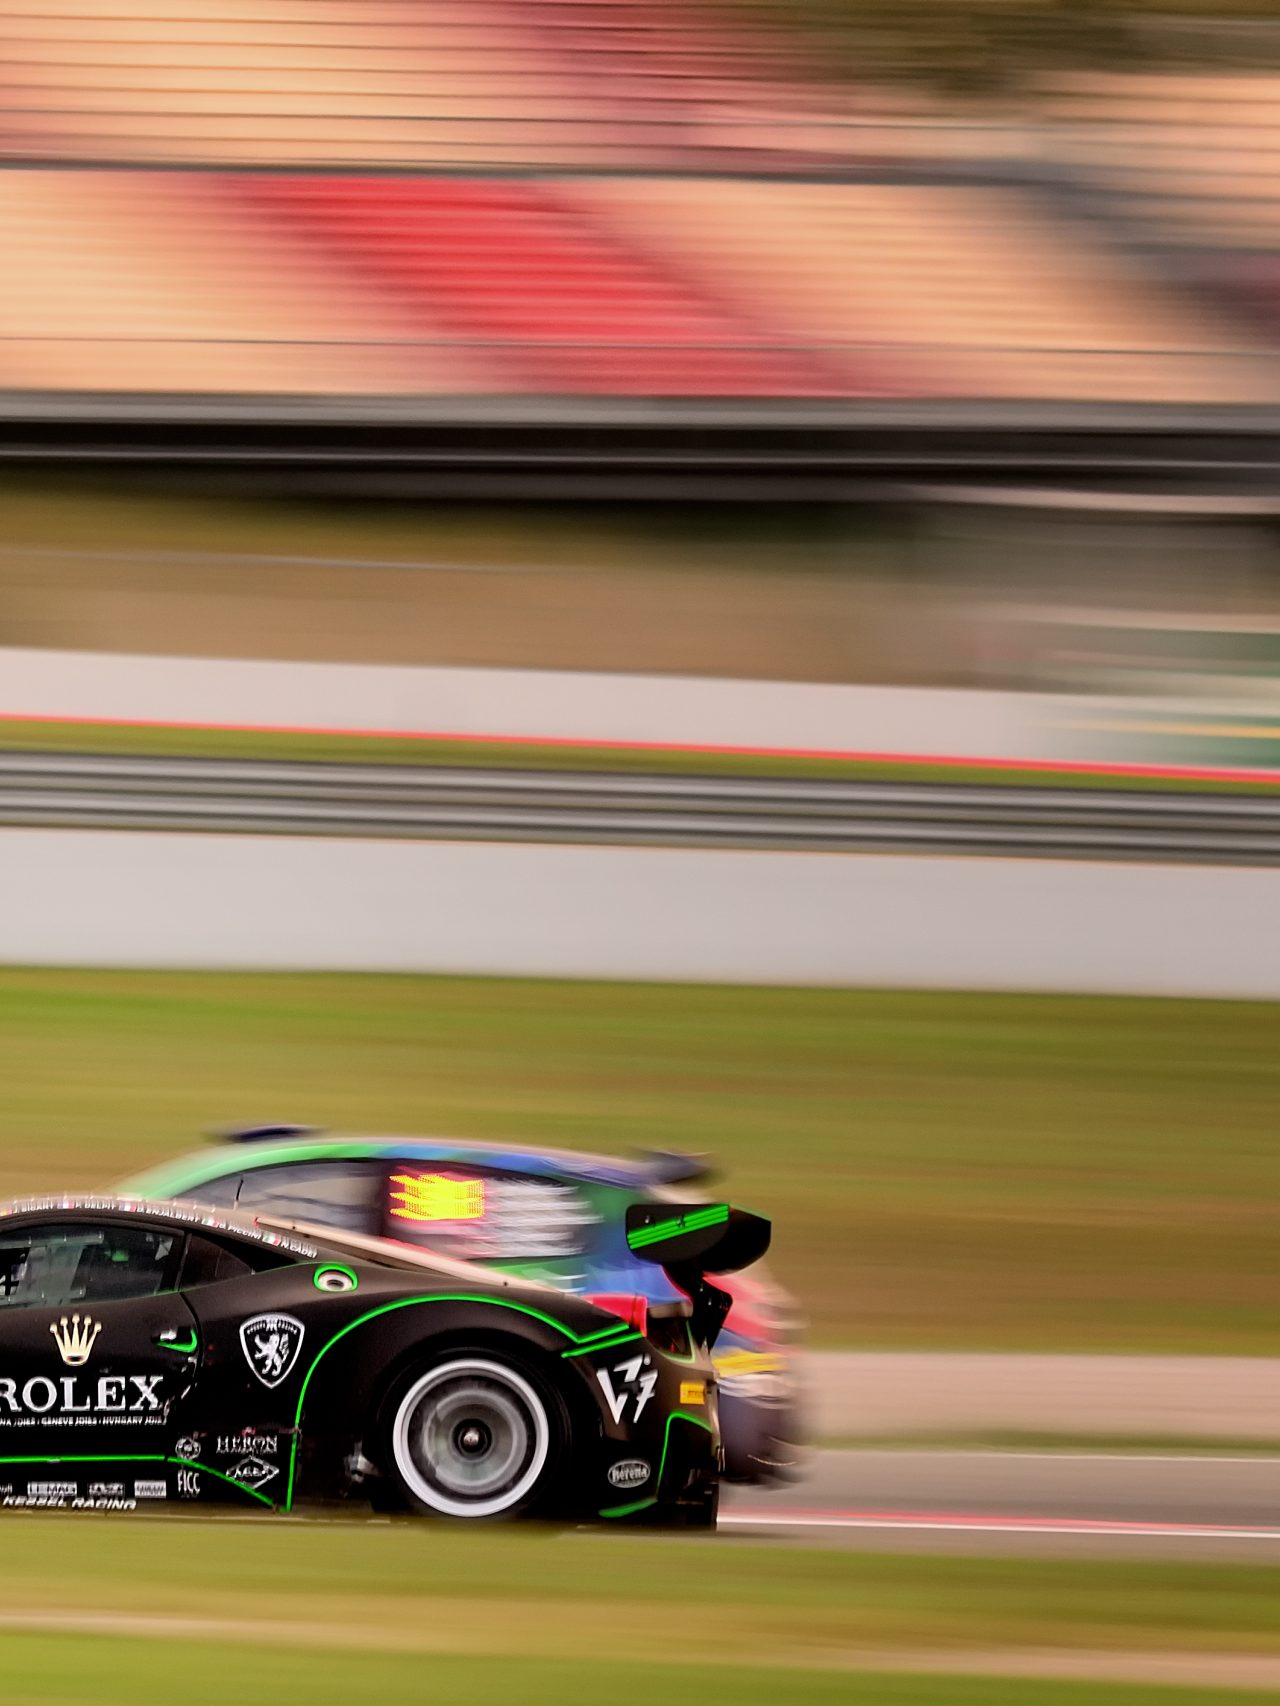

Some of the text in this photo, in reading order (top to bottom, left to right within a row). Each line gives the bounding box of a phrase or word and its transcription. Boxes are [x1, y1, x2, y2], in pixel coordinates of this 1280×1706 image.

[102, 1415, 143, 1426] HUNGARY
[177, 1469, 200, 1494] FICC
[72, 1497, 137, 1510] RACING
